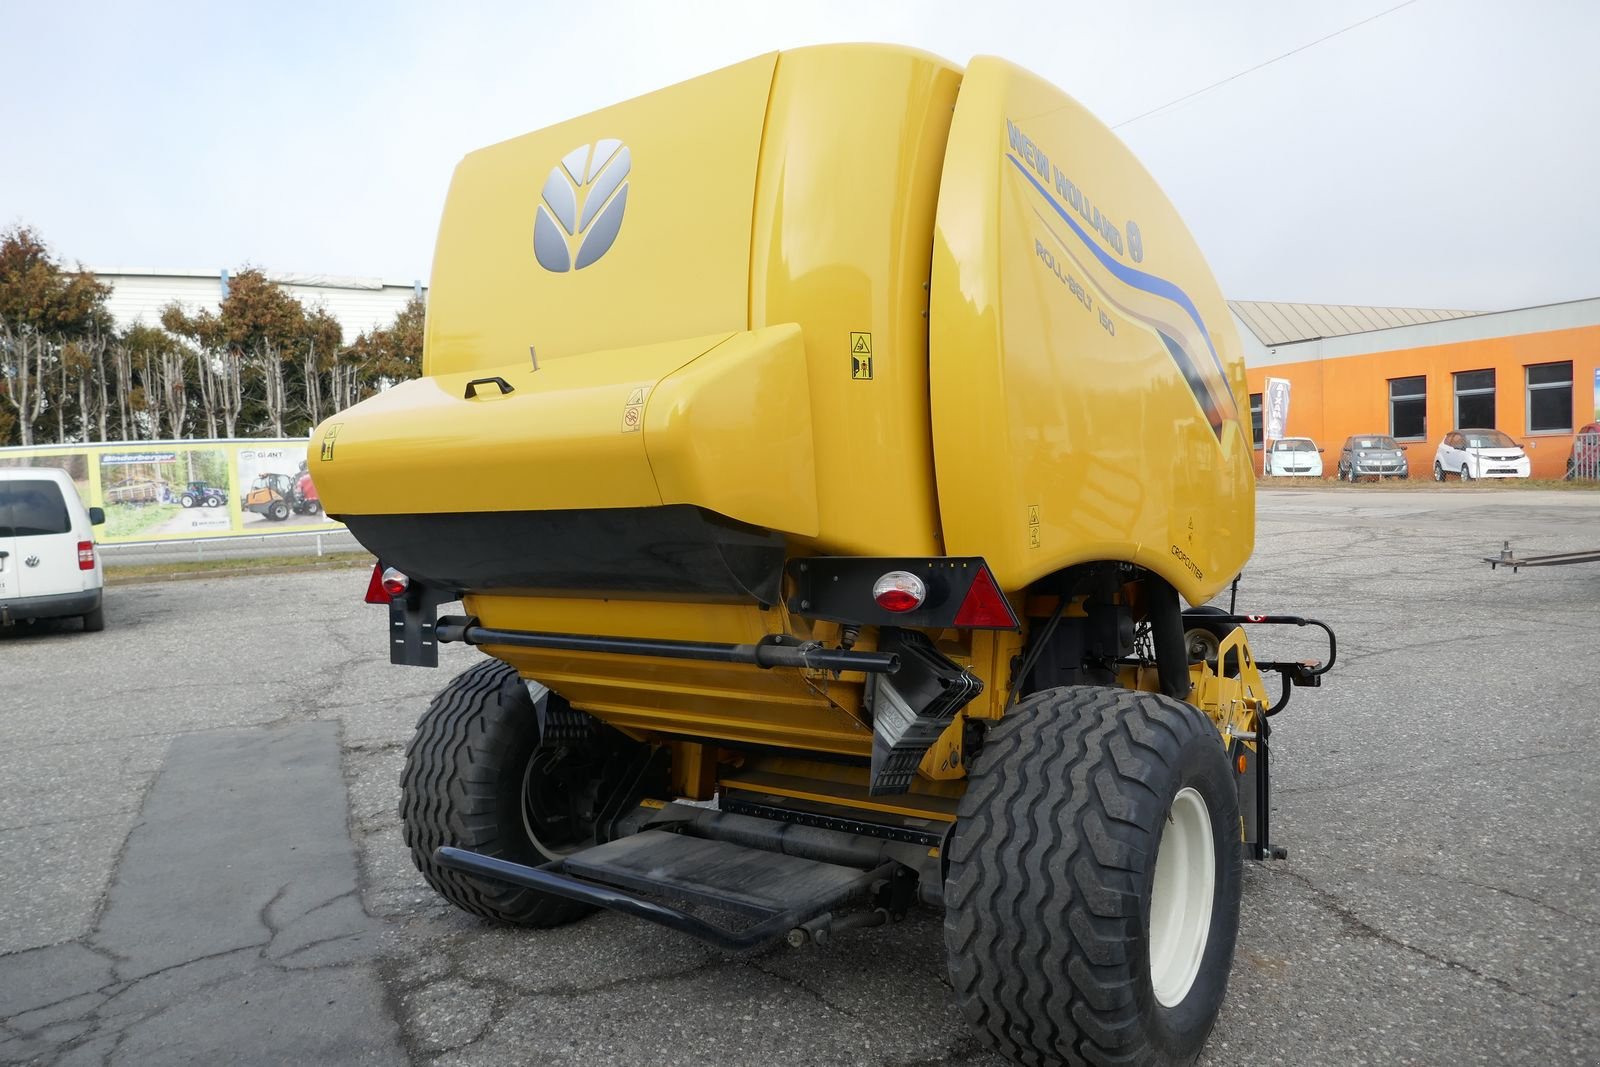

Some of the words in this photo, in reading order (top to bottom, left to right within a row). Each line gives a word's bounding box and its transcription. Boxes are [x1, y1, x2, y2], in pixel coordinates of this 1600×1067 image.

[1006, 118, 1050, 184] NEW
[1053, 164, 1124, 256] HOLLAND
[1035, 238, 1092, 312] ROLL-BELT
[1097, 306, 1115, 336] 150
[1272, 383, 1284, 419] AIXAM
[1171, 545, 1203, 582] CROPCUTTER
